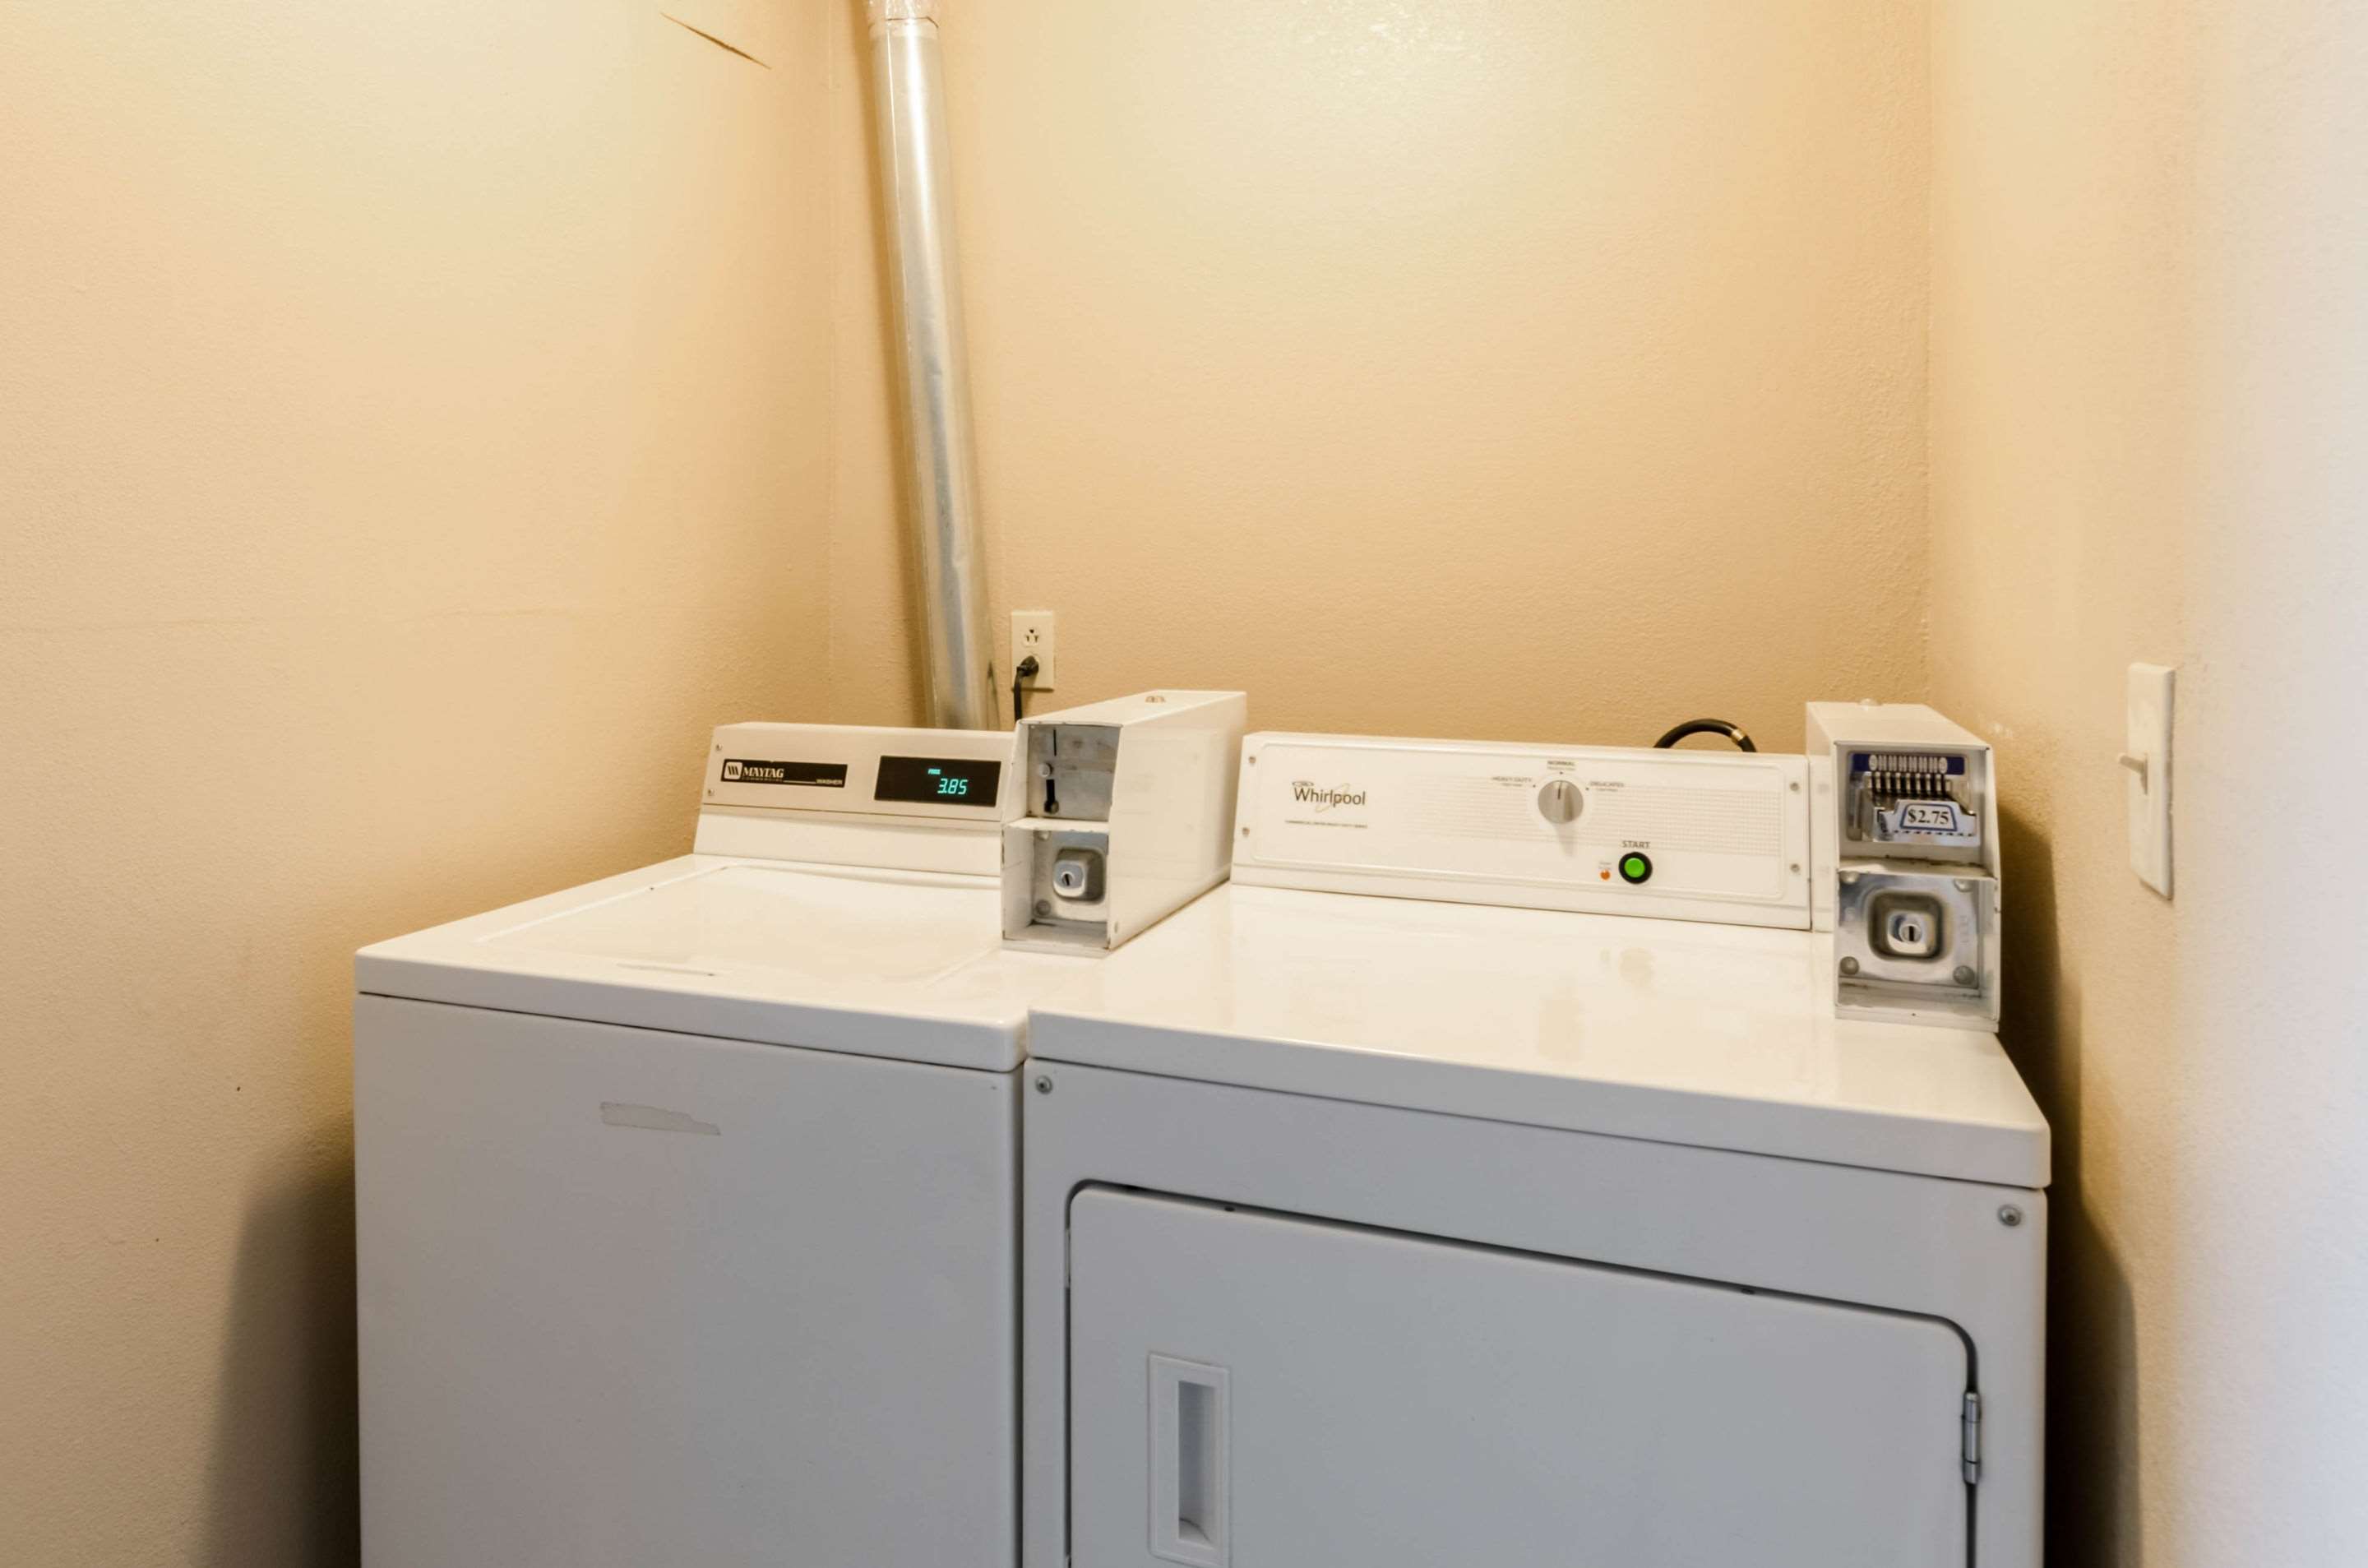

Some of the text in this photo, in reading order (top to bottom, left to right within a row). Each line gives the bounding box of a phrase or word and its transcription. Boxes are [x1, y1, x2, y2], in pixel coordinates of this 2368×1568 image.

[742, 766, 784, 779] MAYTAG
[1293, 787, 1366, 807] Whirlpool
[1908, 809, 1949, 825] $2.75
[1622, 840, 1651, 849] START
